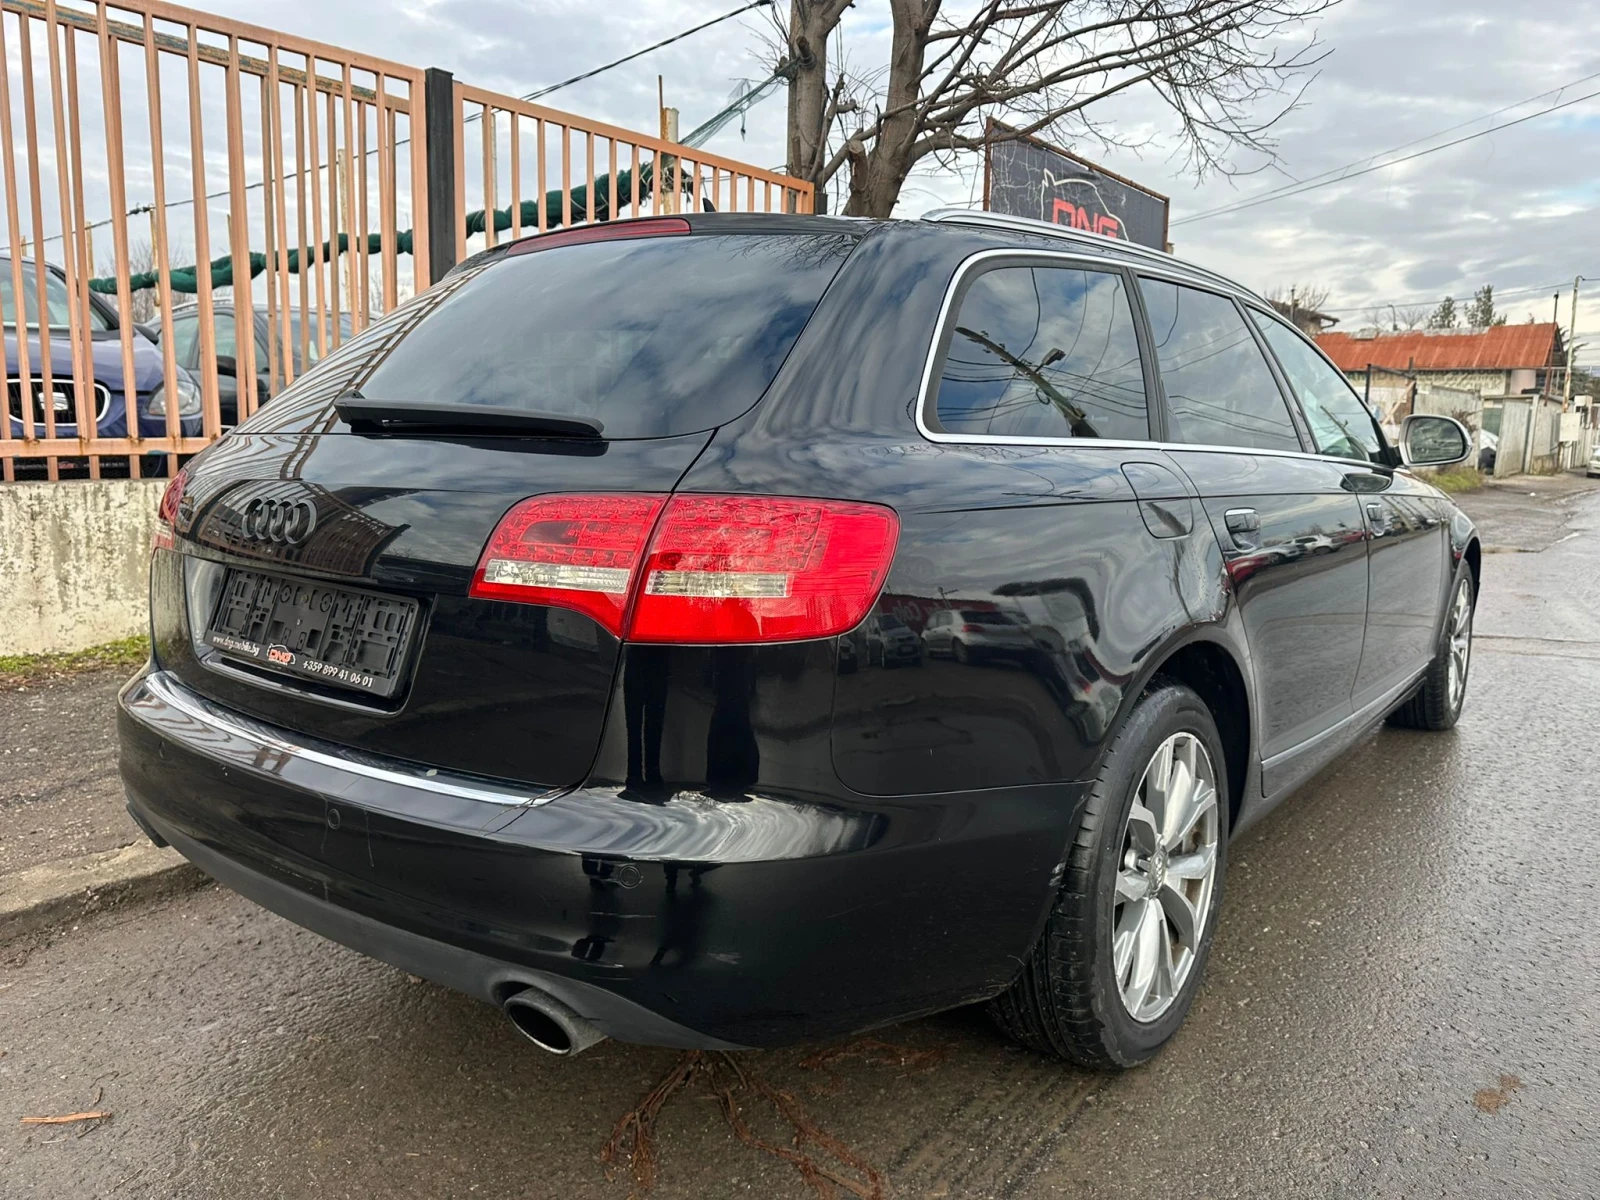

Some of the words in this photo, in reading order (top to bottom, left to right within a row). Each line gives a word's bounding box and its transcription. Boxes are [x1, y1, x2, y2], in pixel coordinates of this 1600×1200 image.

[212, 636, 260, 656] www.dng.mobile.bg
[270, 649, 292, 662] DNG
[303, 660, 322, 673] +359
[322, 664, 338, 677] 899
[338, 669, 348, 680] 41
[350, 672, 361, 684] 06
[362, 676, 373, 688] 01
